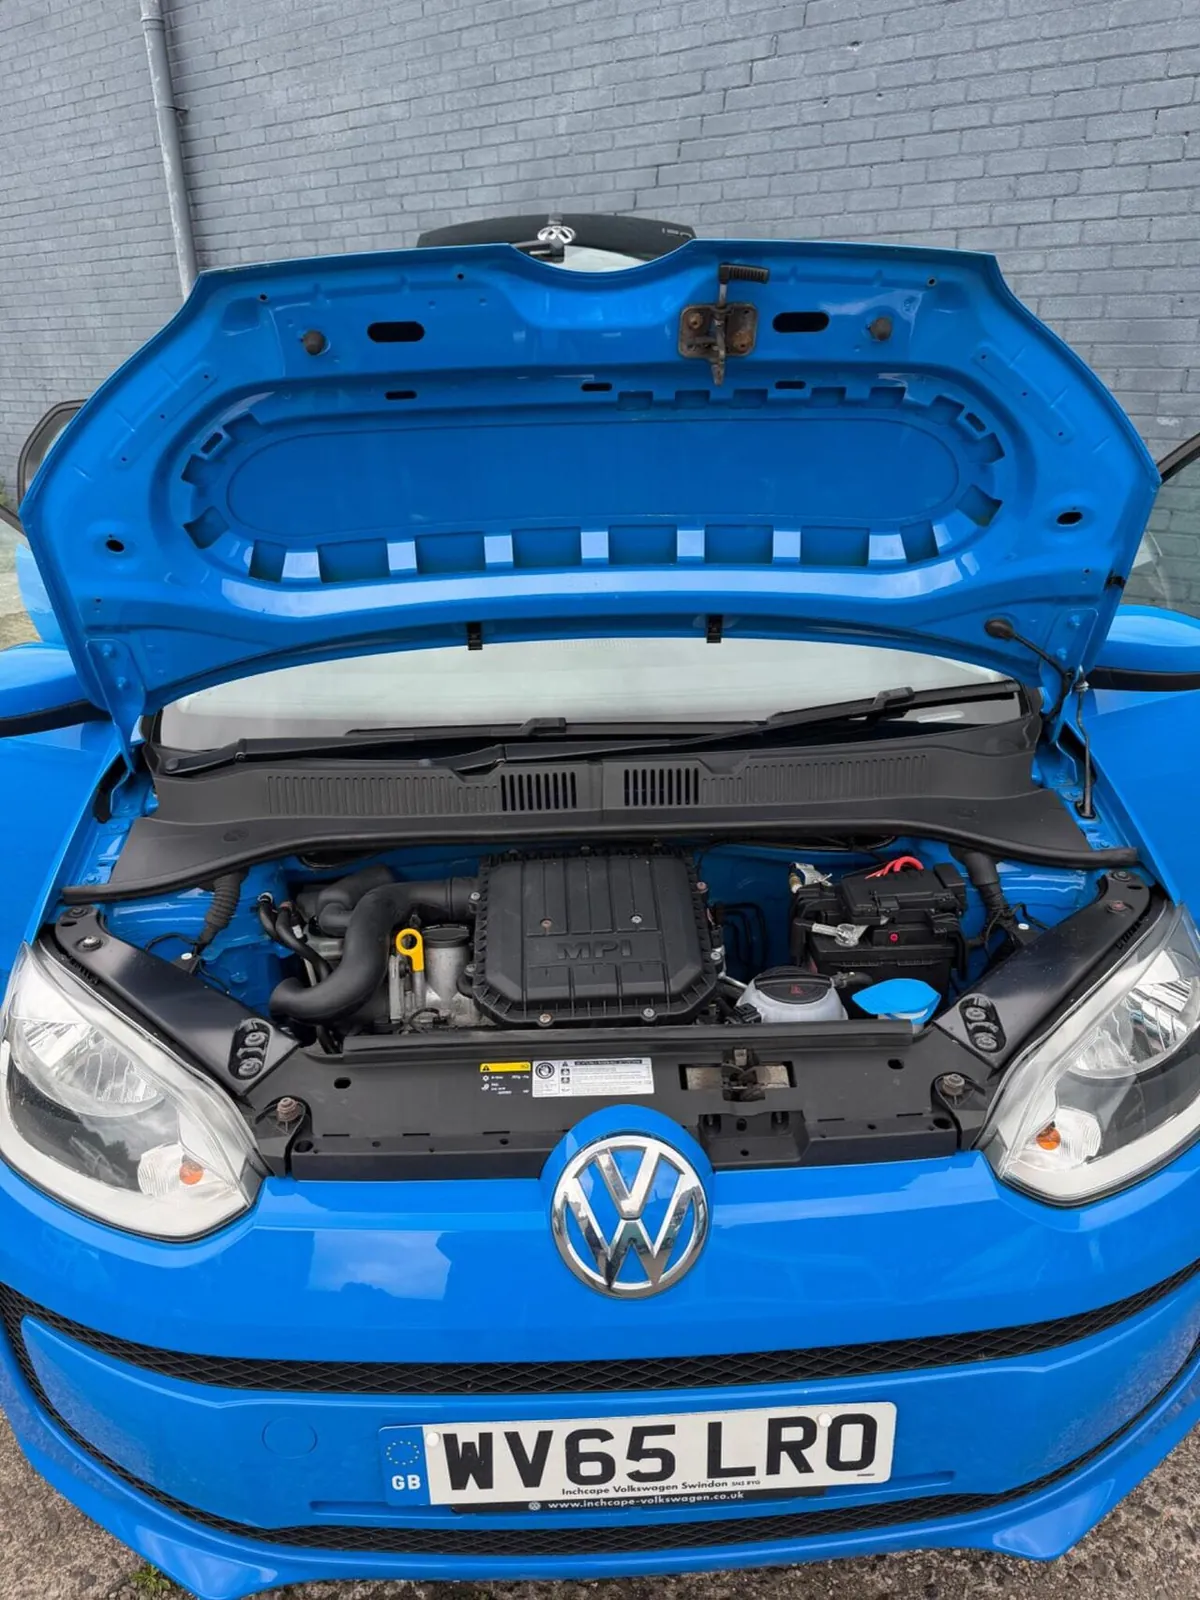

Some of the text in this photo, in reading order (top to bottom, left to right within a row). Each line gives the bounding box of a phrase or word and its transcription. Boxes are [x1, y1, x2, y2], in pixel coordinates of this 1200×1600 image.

[557, 940, 632, 960] MPI
[557, 1146, 698, 1292] VW
[442, 1413, 877, 1491] WV65 LRO
[391, 1474, 421, 1491] GB
[561, 1487, 610, 1497] Inchcape
[613, 1483, 679, 1495] Volkswagen
[681, 1480, 728, 1491] Swindon
[548, 1490, 745, 1510] www.inchcape-volkswagen.co.uk
